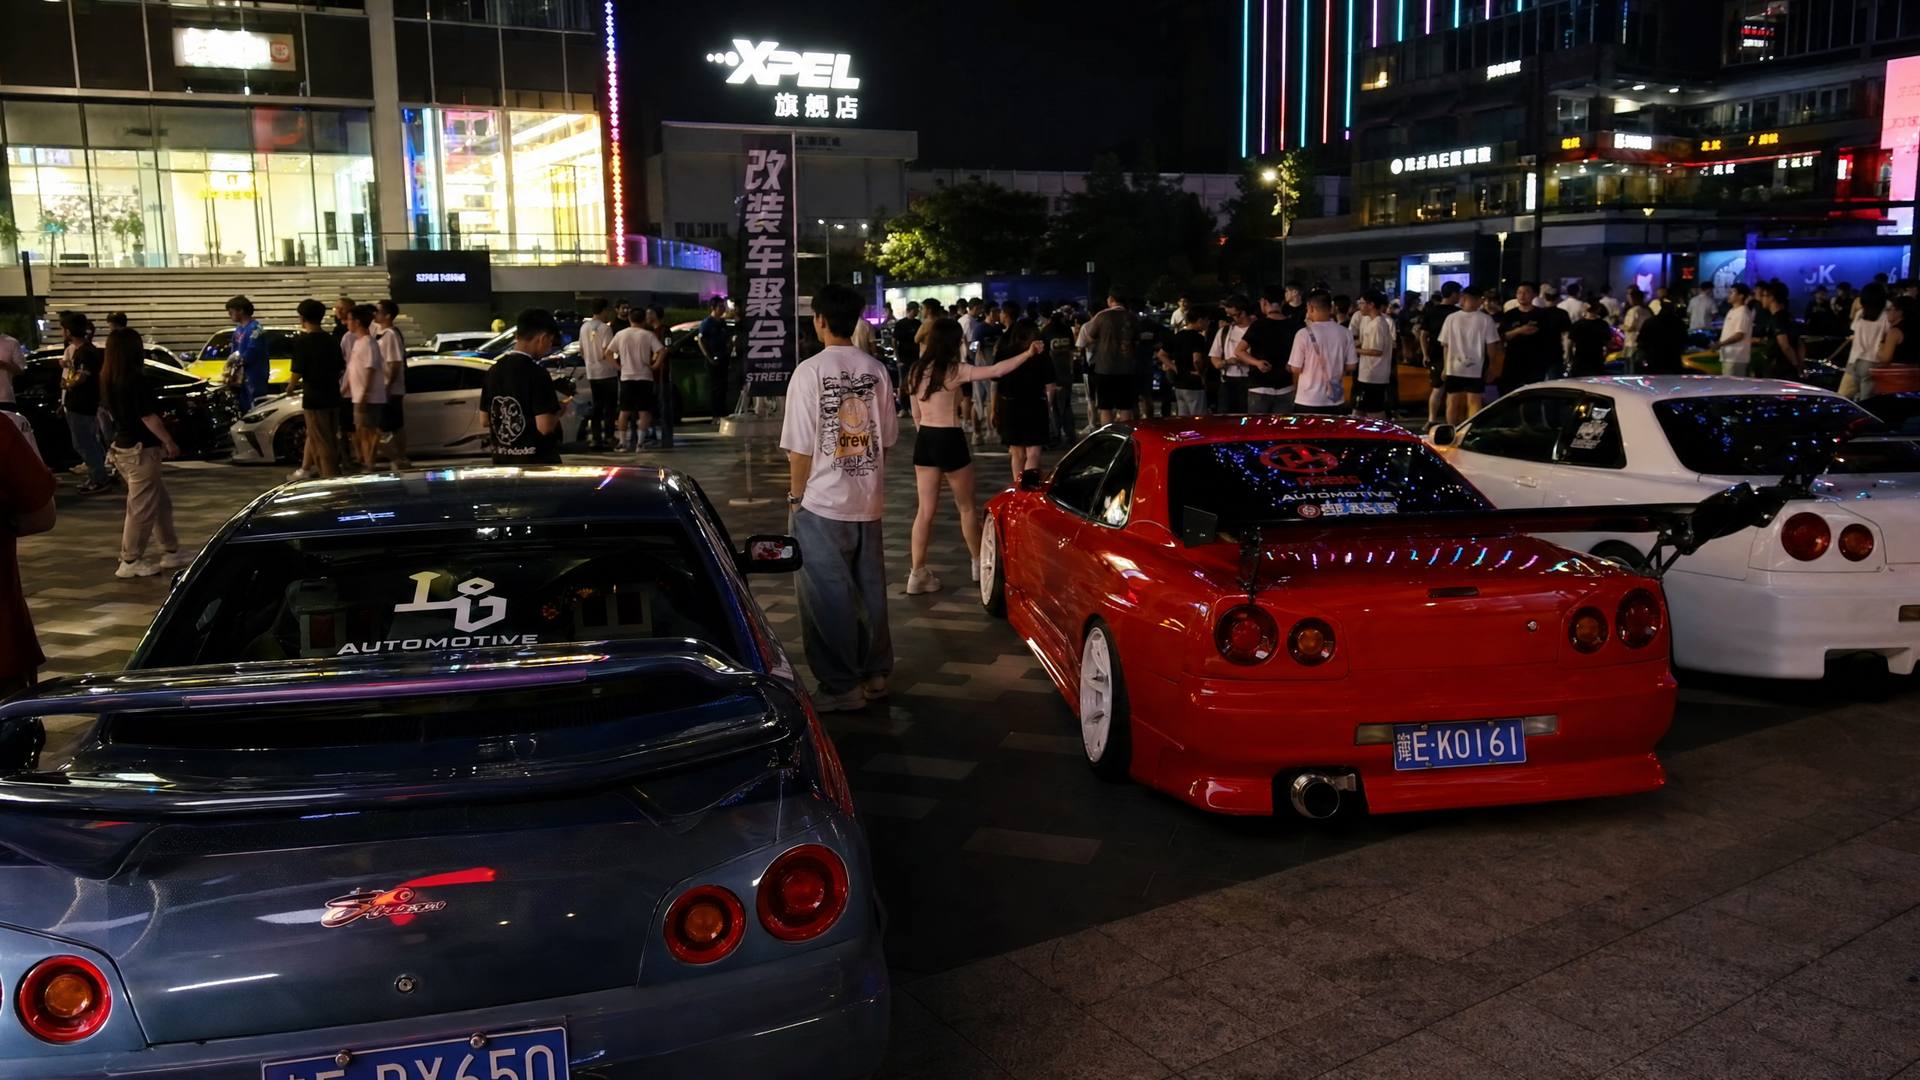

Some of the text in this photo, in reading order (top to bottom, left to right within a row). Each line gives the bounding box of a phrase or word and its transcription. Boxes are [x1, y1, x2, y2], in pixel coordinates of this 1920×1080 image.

[726, 39, 861, 89] XPEL
[774, 92, 859, 119] 旗舰店
[744, 149, 787, 359] 改装车聚会
[746, 371, 791, 382] STREET
[839, 432, 870, 447] drew
[1282, 491, 1395, 501] AUTOMOTIVE
[337, 634, 538, 655] AUTOMOTIVE
